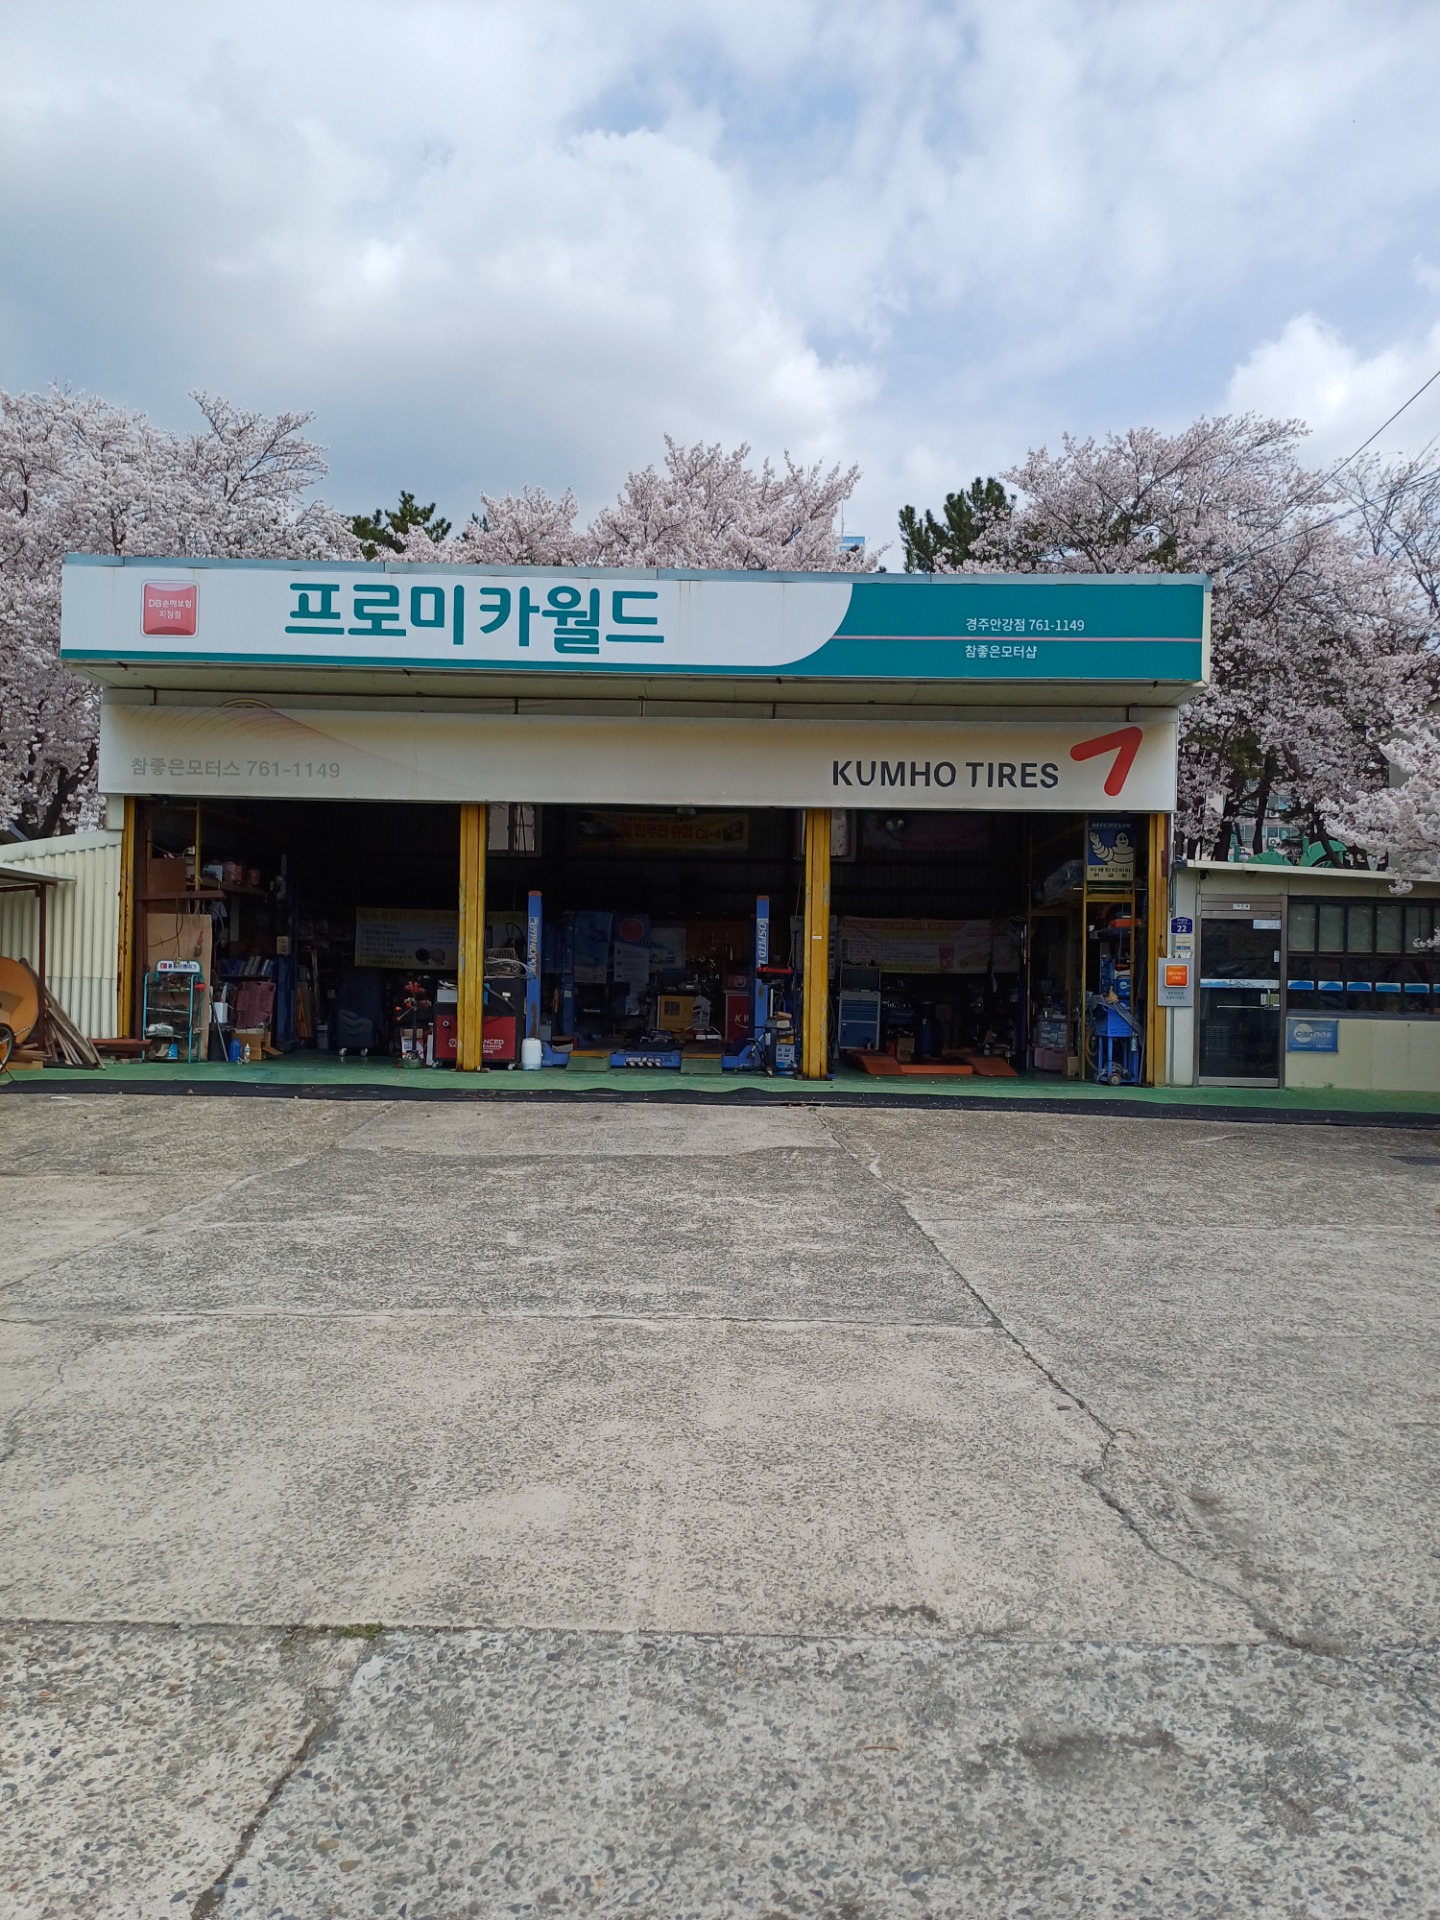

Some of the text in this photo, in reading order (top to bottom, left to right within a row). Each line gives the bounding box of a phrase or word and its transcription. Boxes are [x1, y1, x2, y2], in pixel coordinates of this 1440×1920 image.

[965, 617, 1085, 632] 경주안강점 761-1149
[965, 645, 1038, 659] 참좋은모터샵
[131, 757, 341, 778] 참좋은모터스 761-1149
[832, 760, 1059, 788] KUMHO TIRES
[1177, 925, 1187, 933] 22
